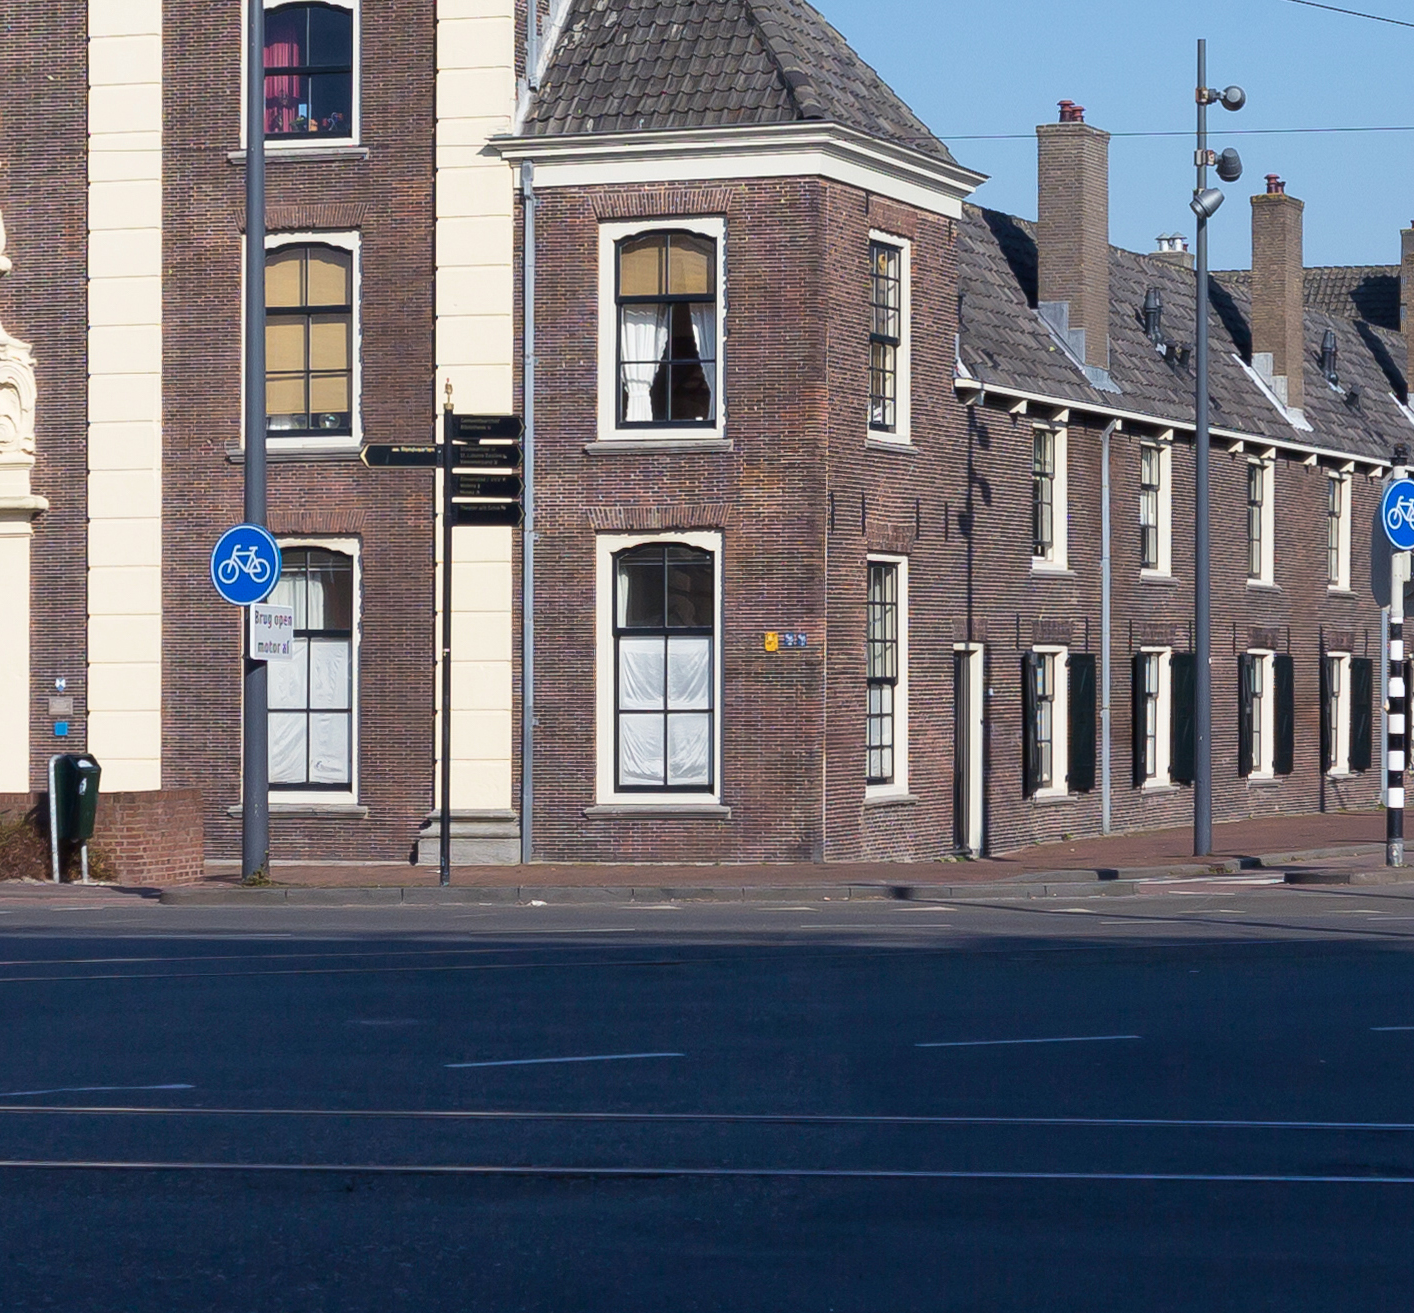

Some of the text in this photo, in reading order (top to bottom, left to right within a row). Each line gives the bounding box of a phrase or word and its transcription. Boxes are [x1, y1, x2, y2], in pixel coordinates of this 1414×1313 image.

[255, 610, 292, 629] Brug open
[258, 641, 290, 654] motor af
